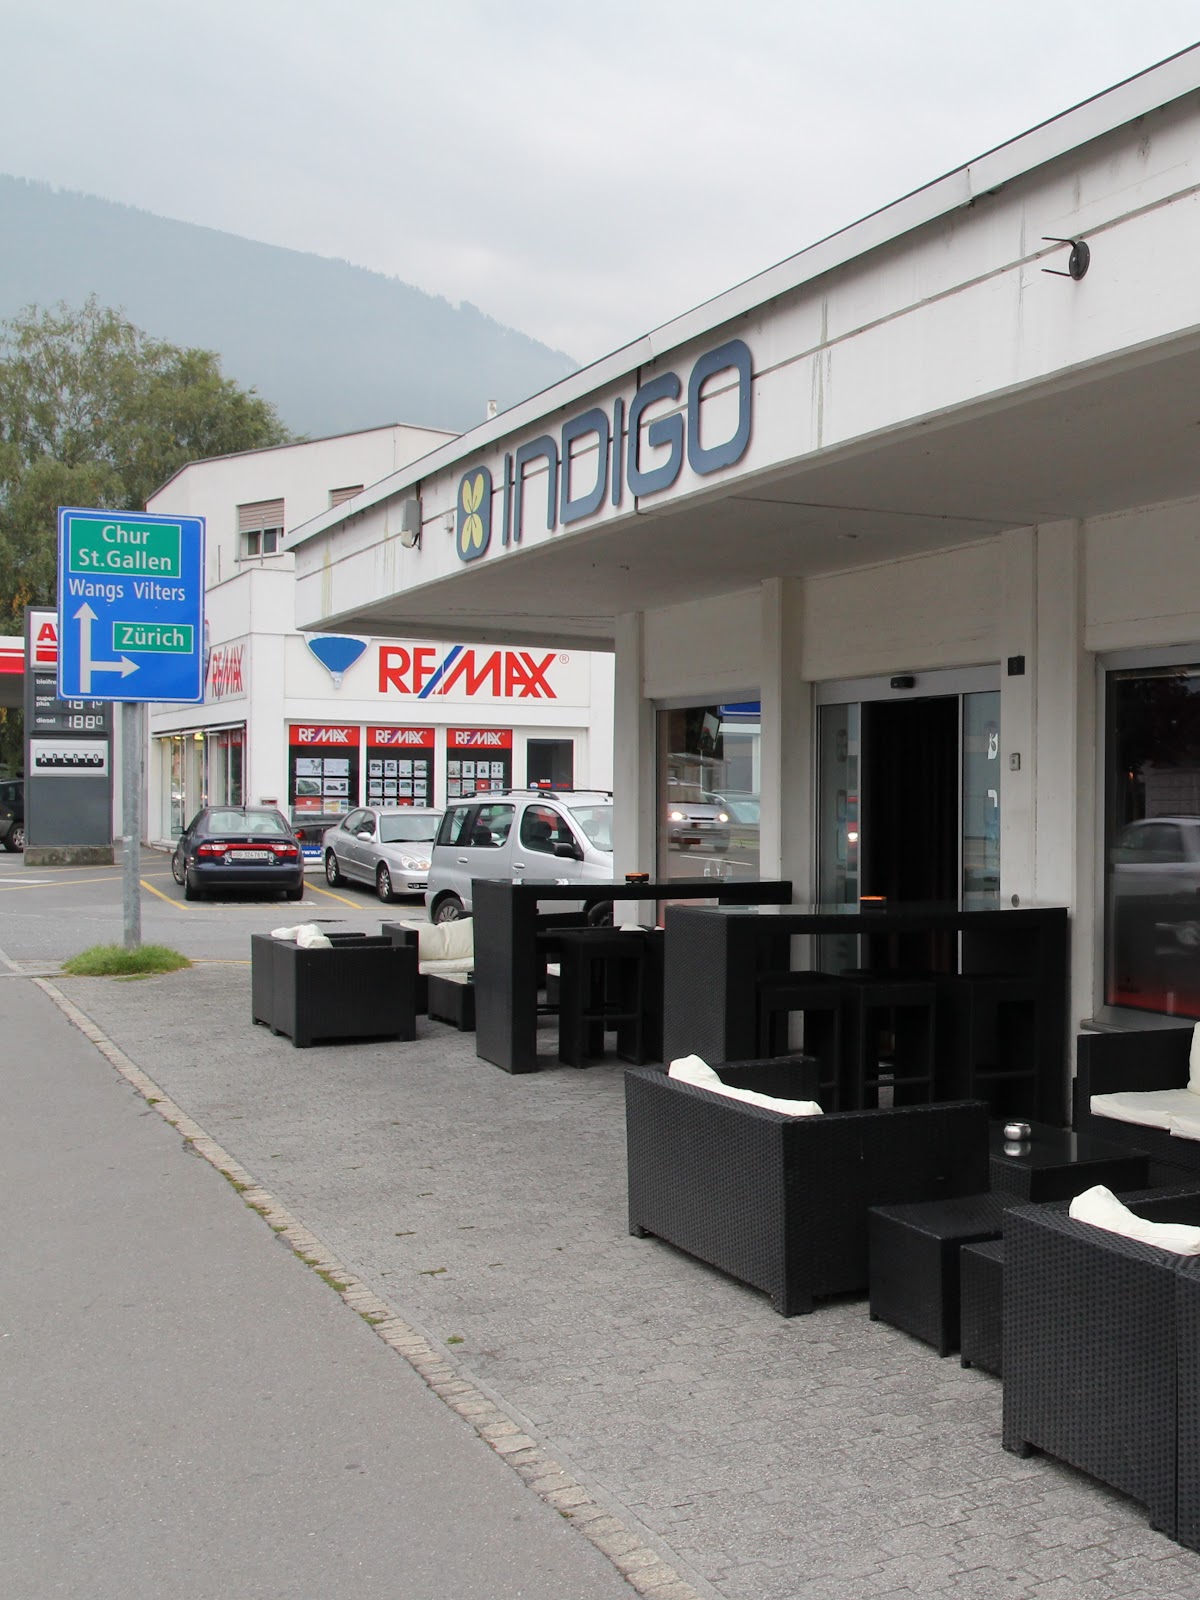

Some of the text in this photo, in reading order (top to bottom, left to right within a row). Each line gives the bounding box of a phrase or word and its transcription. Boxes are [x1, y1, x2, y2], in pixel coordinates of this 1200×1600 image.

[502, 339, 751, 546] INDIGO
[102, 525, 150, 545] Chur
[78, 548, 172, 571] St.Gallen
[68, 578, 186, 602] Wangs Vilters
[122, 627, 184, 647] Zürich
[378, 645, 558, 699] RE/MAX
[298, 728, 349, 744] RE/MAX
[375, 729, 425, 744] RE/MAX
[455, 731, 502, 745] RE/MAX
[40, 753, 99, 764] APERTO
